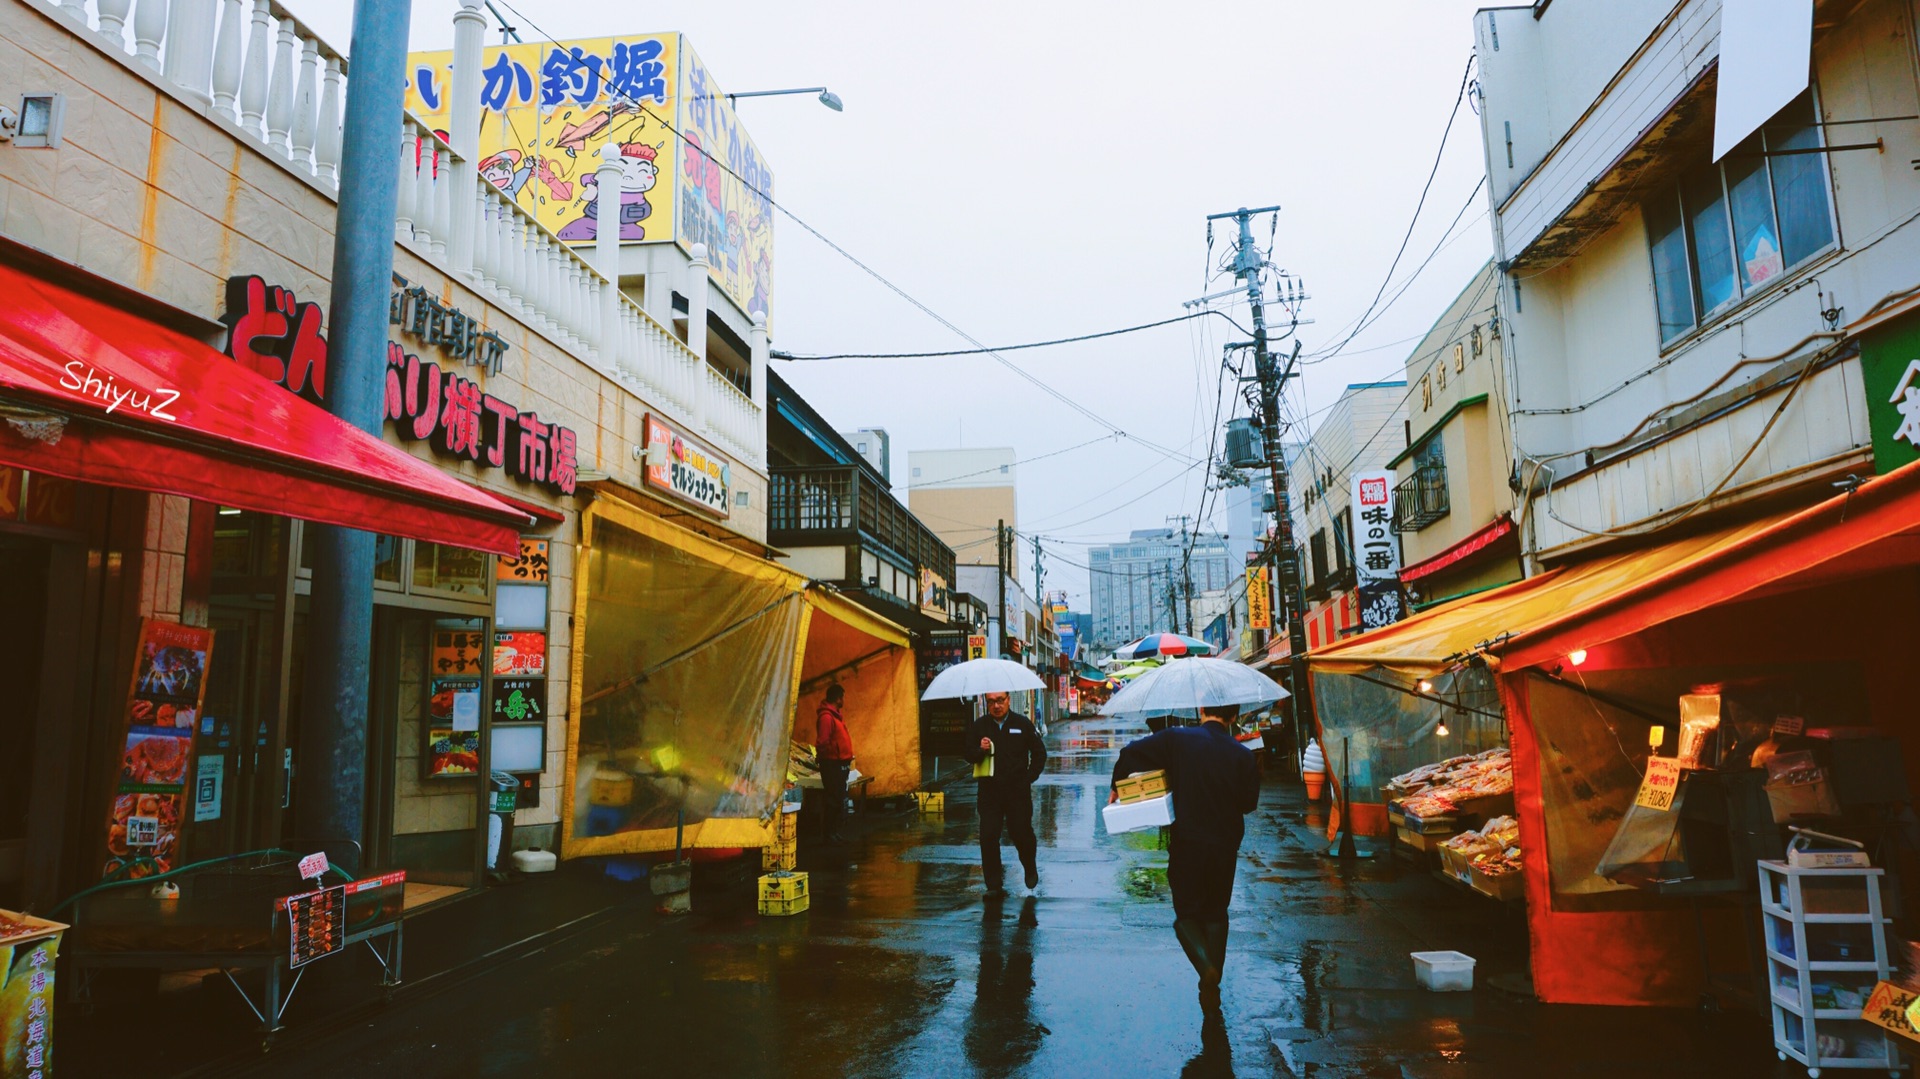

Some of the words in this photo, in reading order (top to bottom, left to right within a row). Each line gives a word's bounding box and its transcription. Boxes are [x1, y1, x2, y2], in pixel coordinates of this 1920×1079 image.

[403, 41, 664, 110] いか釣堀
[689, 56, 773, 221] 活いか釣堀
[1361, 506, 1393, 570] 味の一番
[969, 637, 986, 647] 500
